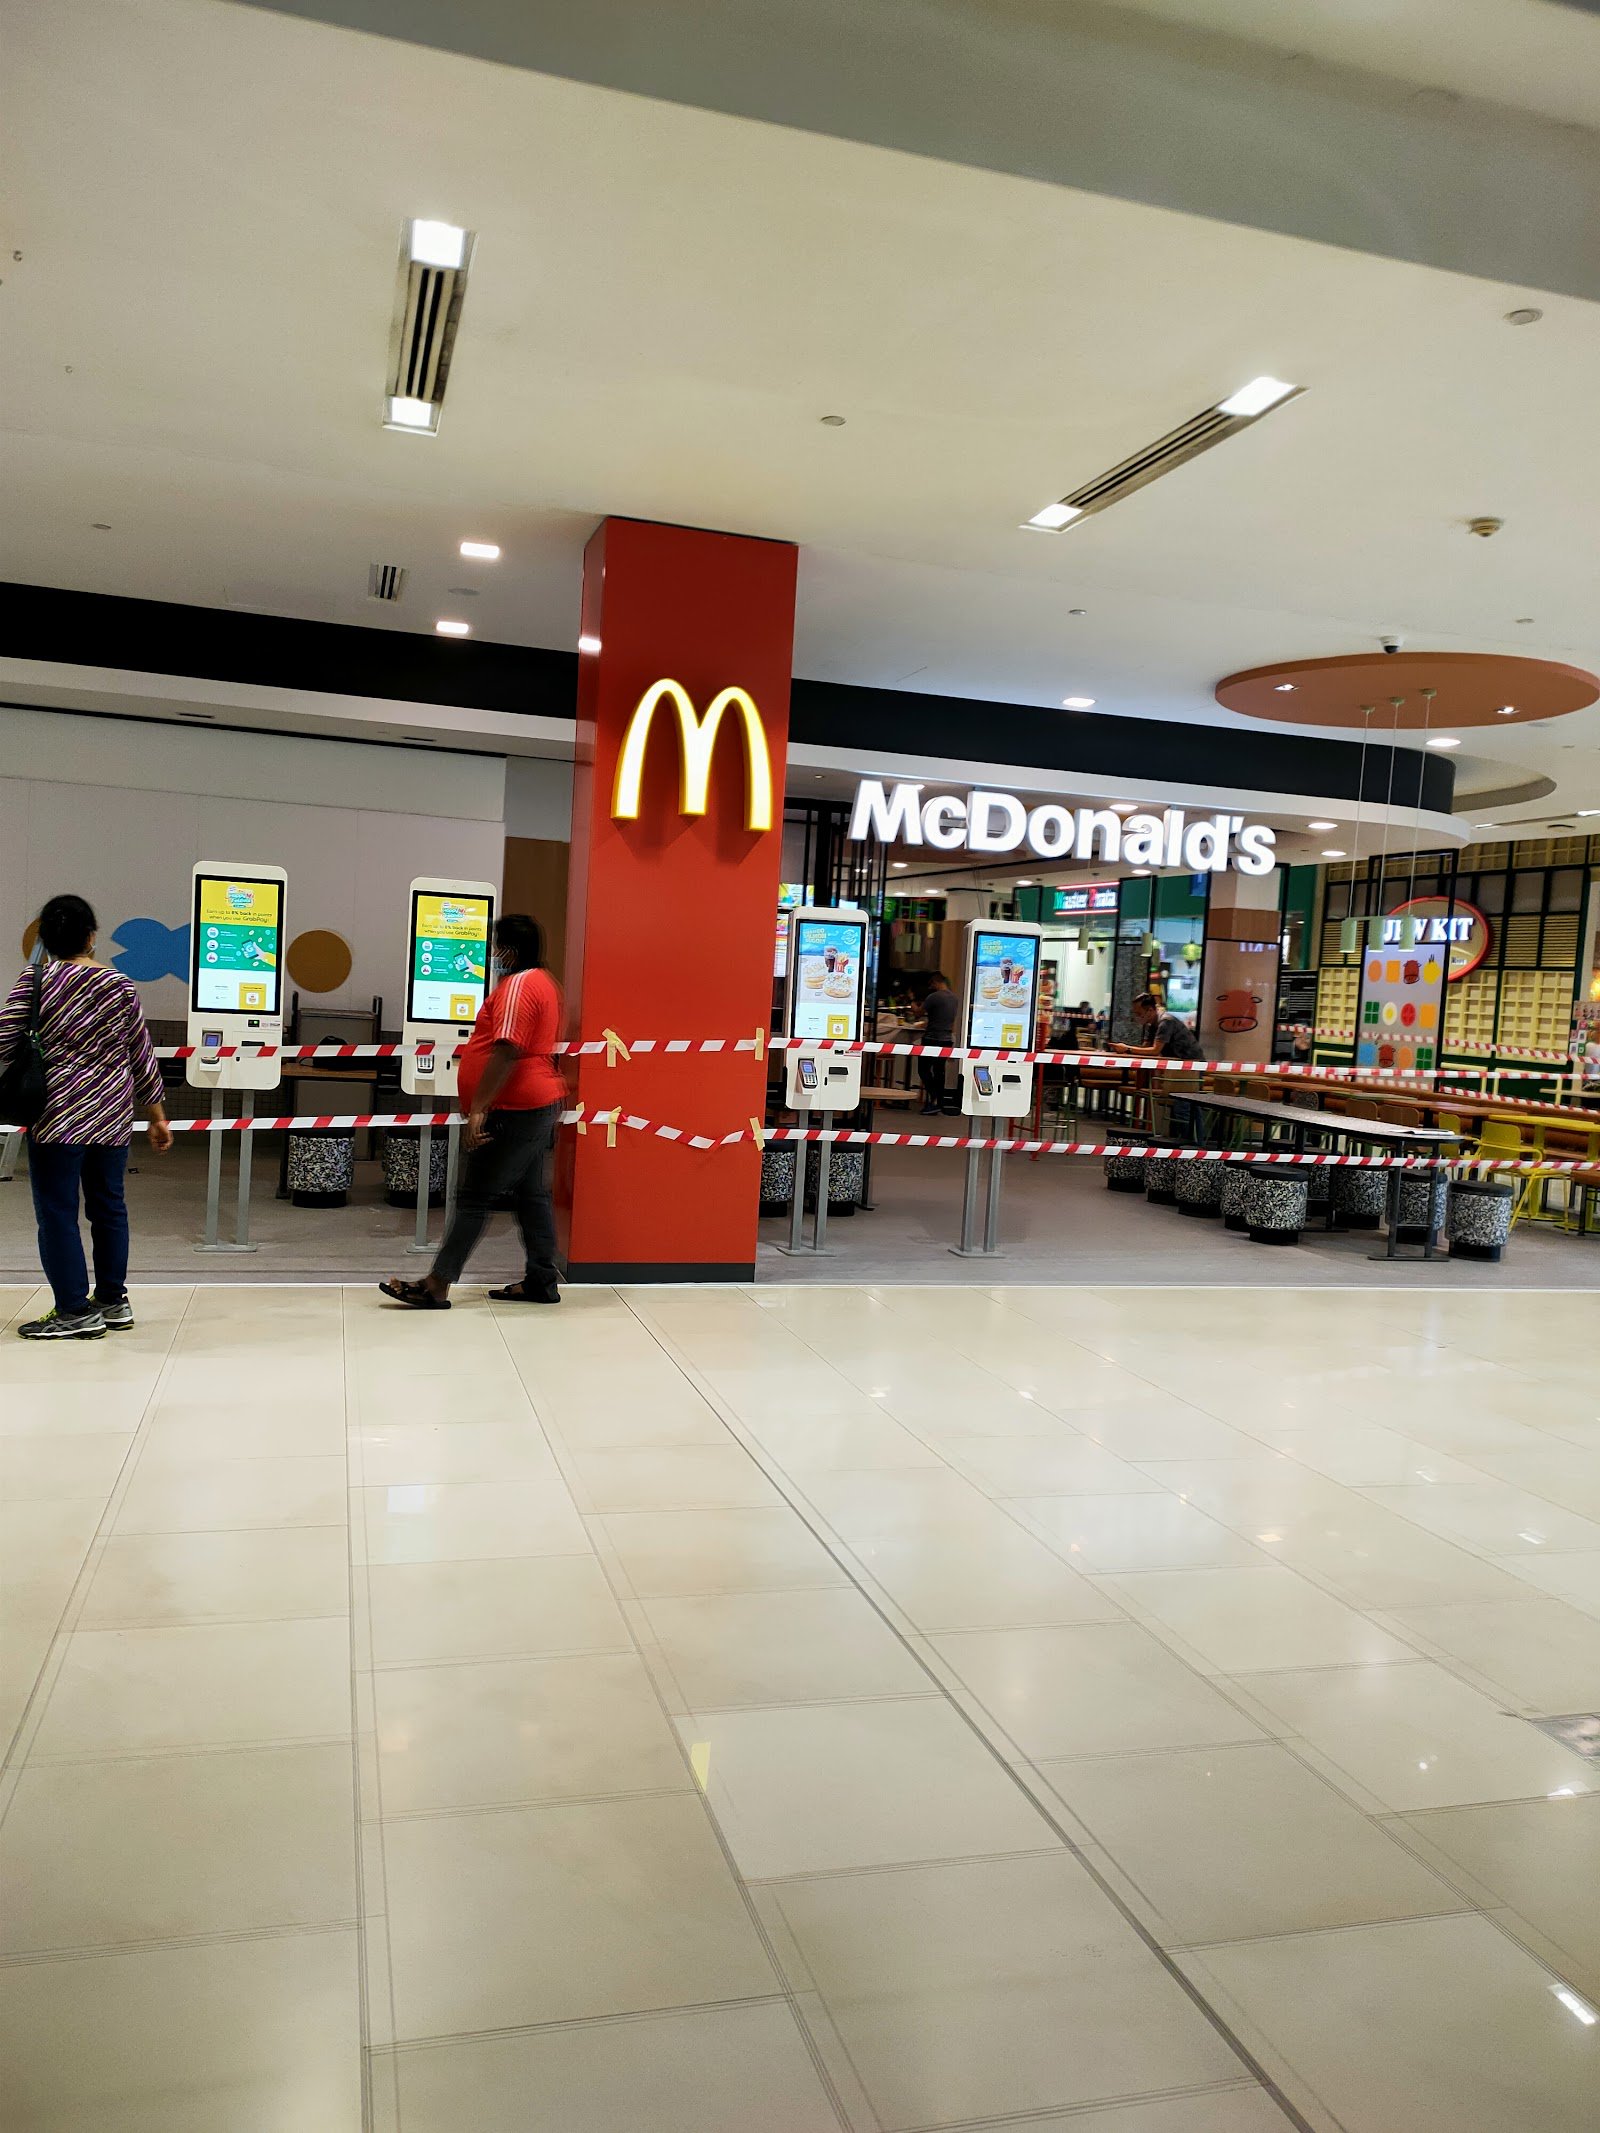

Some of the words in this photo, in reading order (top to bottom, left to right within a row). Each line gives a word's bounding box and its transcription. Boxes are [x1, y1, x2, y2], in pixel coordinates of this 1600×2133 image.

[611, 678, 773, 831] M
[848, 779, 1276, 875] McDonald's
[1430, 917, 1474, 941] KIT
